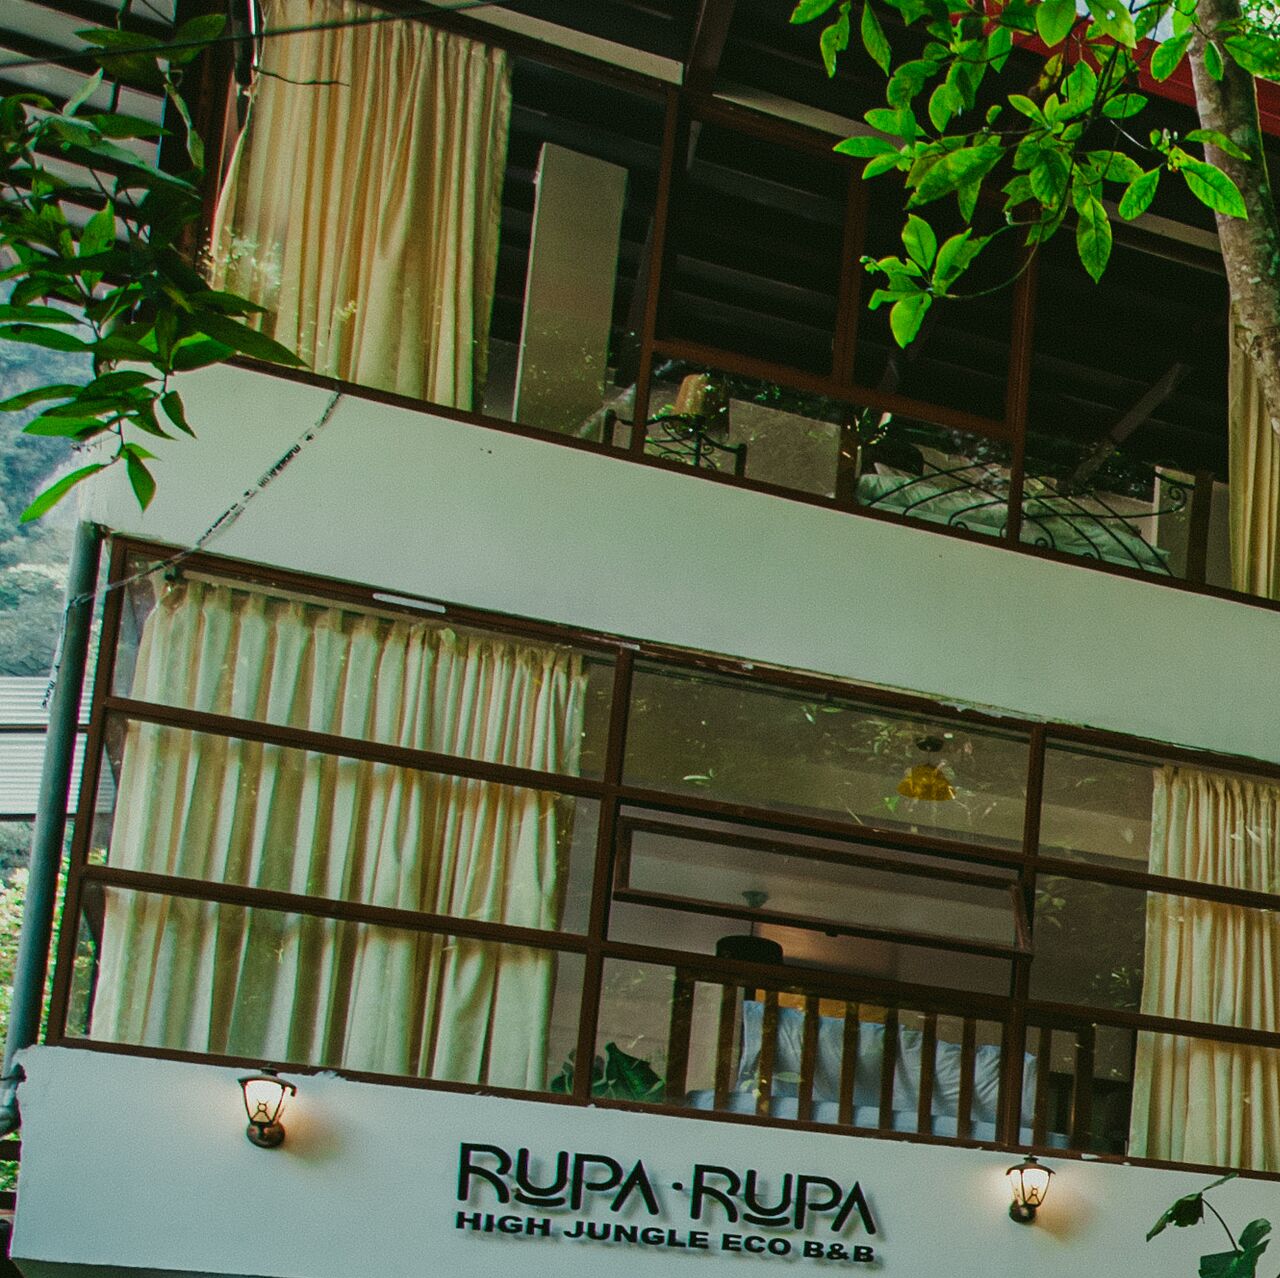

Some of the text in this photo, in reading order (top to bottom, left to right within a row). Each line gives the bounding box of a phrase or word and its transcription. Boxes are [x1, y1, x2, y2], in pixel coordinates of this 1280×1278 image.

[457, 1141, 877, 1236] RUPA RUPA
[455, 1210, 876, 1264] HIGH JUNGLE ECO B&B
